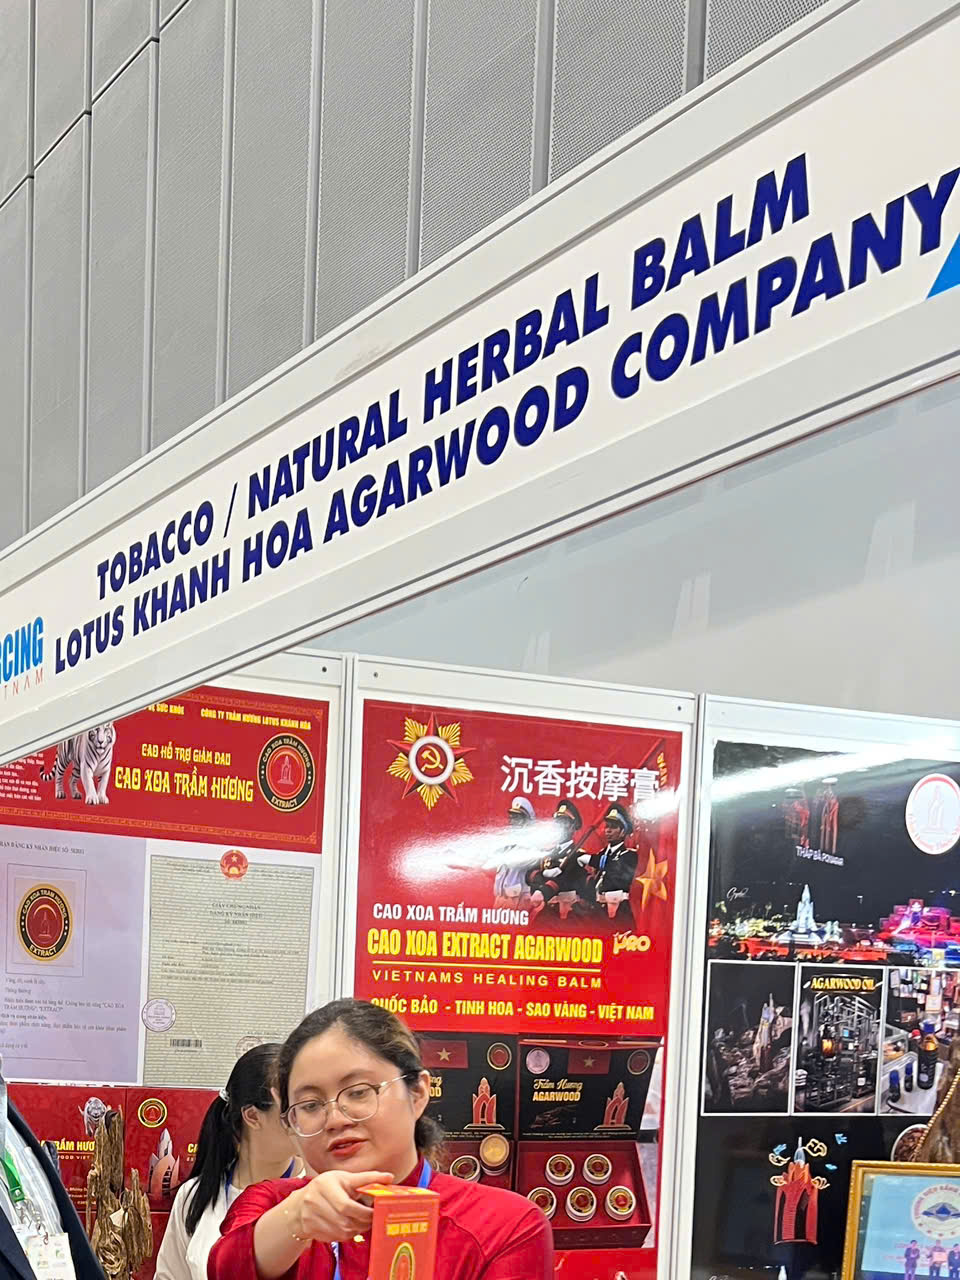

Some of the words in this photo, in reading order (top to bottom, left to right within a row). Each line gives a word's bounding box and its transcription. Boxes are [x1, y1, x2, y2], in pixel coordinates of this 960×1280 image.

[97, 500, 214, 600] TOBACCO
[224, 481, 238, 538] /
[248, 388, 408, 519] NATURAL
[423, 272, 610, 424] HERBAL
[631, 152, 809, 311] BALM
[55, 605, 124, 674] LOTUS
[133, 548, 231, 636] KHANH
[242, 507, 313, 583] HOA
[323, 366, 589, 544] AGARWOOD
[611, 167, 960, 399] COMPANY
[115, 765, 141, 791] CAO
[144, 769, 171, 794] XOA
[211, 775, 254, 802] HƯƠNG
[500, 754, 660, 803] 沉香按摩膏
[270, 795, 298, 809] EXTRACT
[373, 903, 402, 920] CAO
[406, 905, 434, 921] XOA
[481, 908, 529, 925] HƯƠNG
[367, 928, 401, 956] CAO
[405, 930, 437, 956] XOA
[442, 931, 511, 959] EXTRACT
[514, 935, 603, 963] AGARWOOD
[372, 970, 464, 984] VIETNAMS
[473, 973, 549, 986] HEALING
[558, 976, 602, 989] BALM
[811, 977, 862, 991] AGARWOOD
[455, 1000, 485, 1016] TINH
[488, 1001, 514, 1016] HOA
[526, 1002, 551, 1017] SAO
[626, 1006, 654, 1020] NAM
[532, 1091, 581, 1103] AGARWOOD
[76, 1140, 97, 1151] HƯƠ
